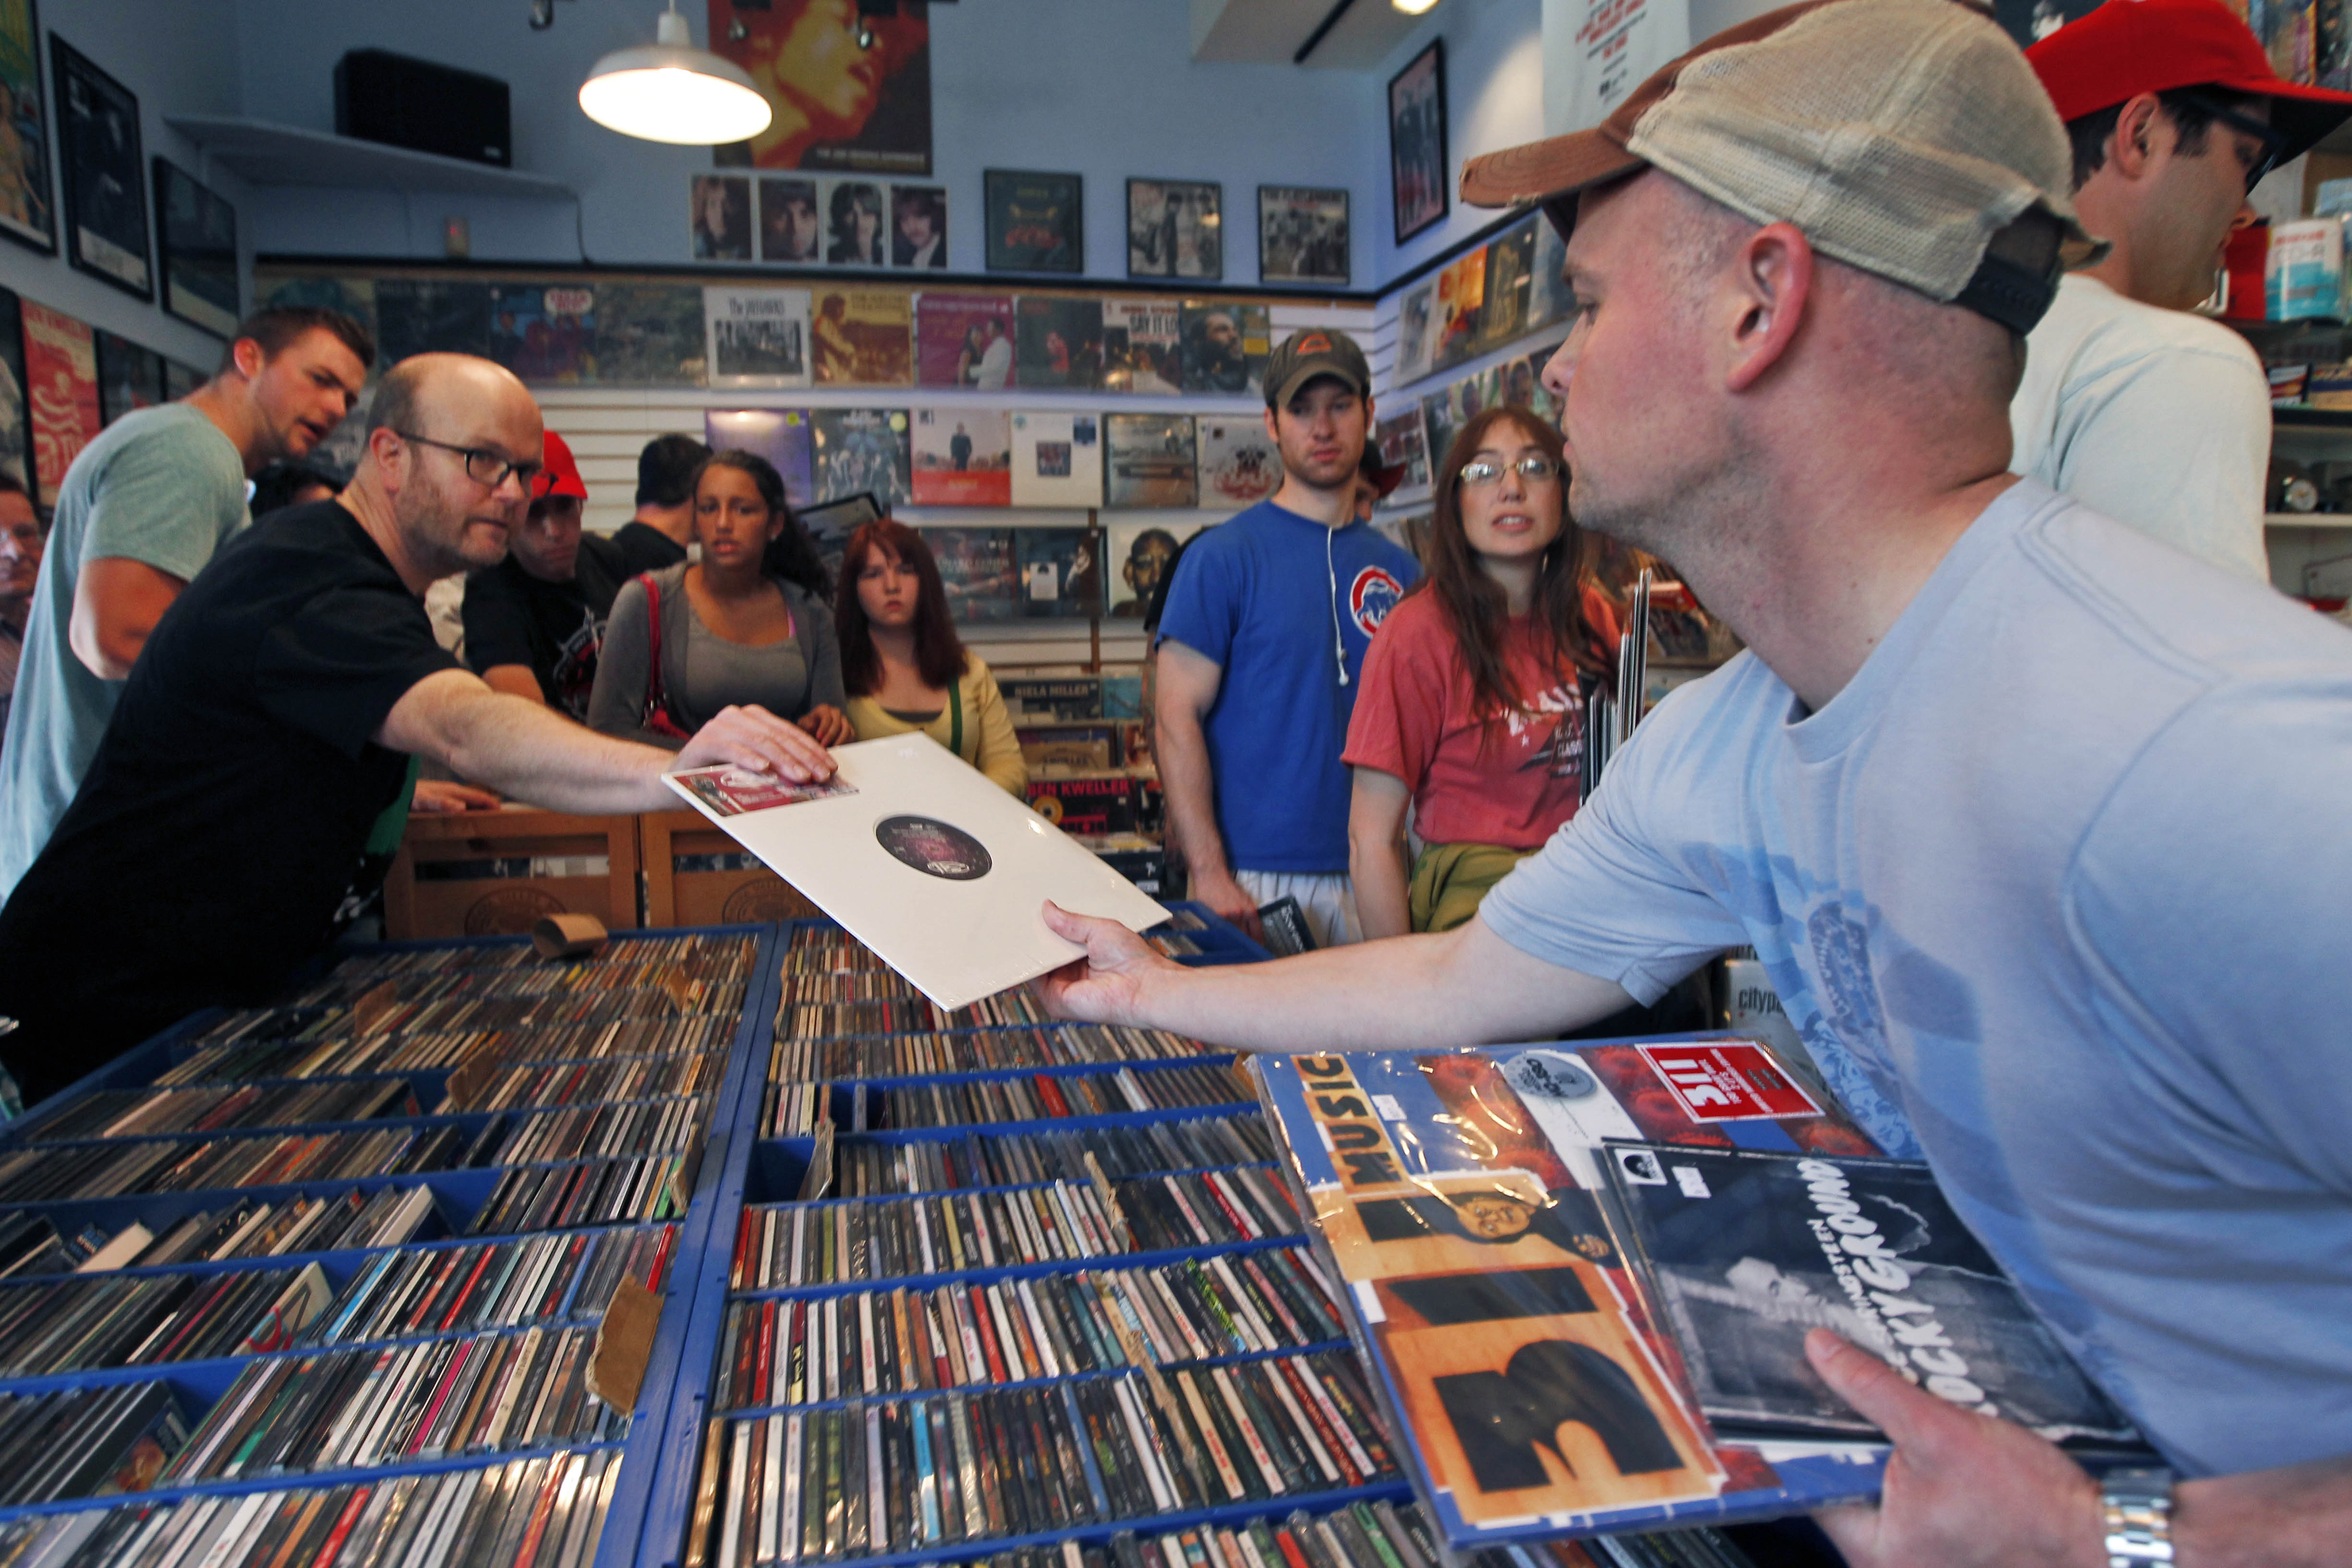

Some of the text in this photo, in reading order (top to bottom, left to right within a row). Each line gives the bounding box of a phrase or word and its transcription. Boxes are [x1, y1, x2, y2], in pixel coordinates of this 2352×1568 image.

[1049, 684, 1089, 696] MILLER
[1028, 777, 1129, 796] BEN KWELLER
[1298, 1058, 1401, 1185] MUSIC
[1659, 1059, 1730, 1107] 311
[1796, 1159, 1912, 1292] GROUND
[1806, 1217, 1894, 1349] SPRINGSTEEN
